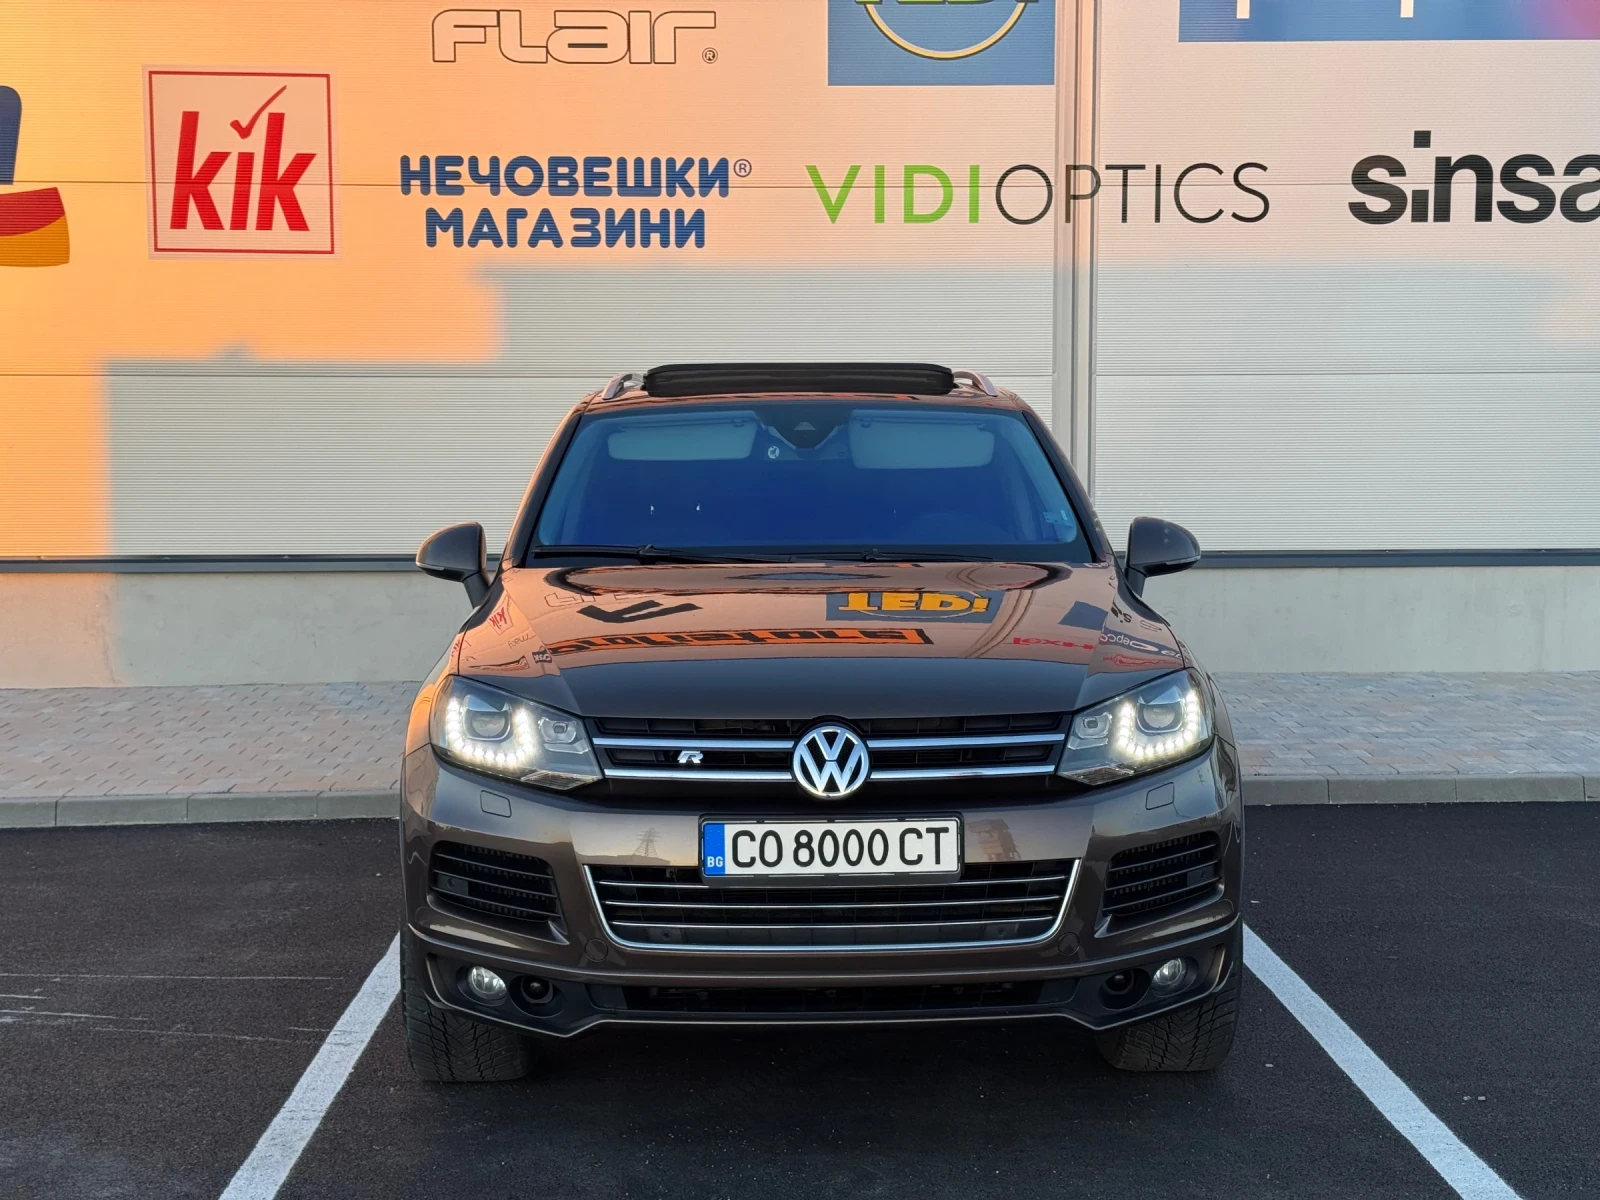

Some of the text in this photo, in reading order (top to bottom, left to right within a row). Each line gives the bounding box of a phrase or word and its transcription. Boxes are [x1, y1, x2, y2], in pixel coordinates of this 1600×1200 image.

[401, 155, 730, 197] НЕЧОВЕШКИ
[425, 208, 706, 248] МАГАЗИНИ
[677, 751, 703, 764] R
[707, 856, 724, 868] BG
[793, 828, 889, 867] 8000
[899, 826, 949, 865] CT
